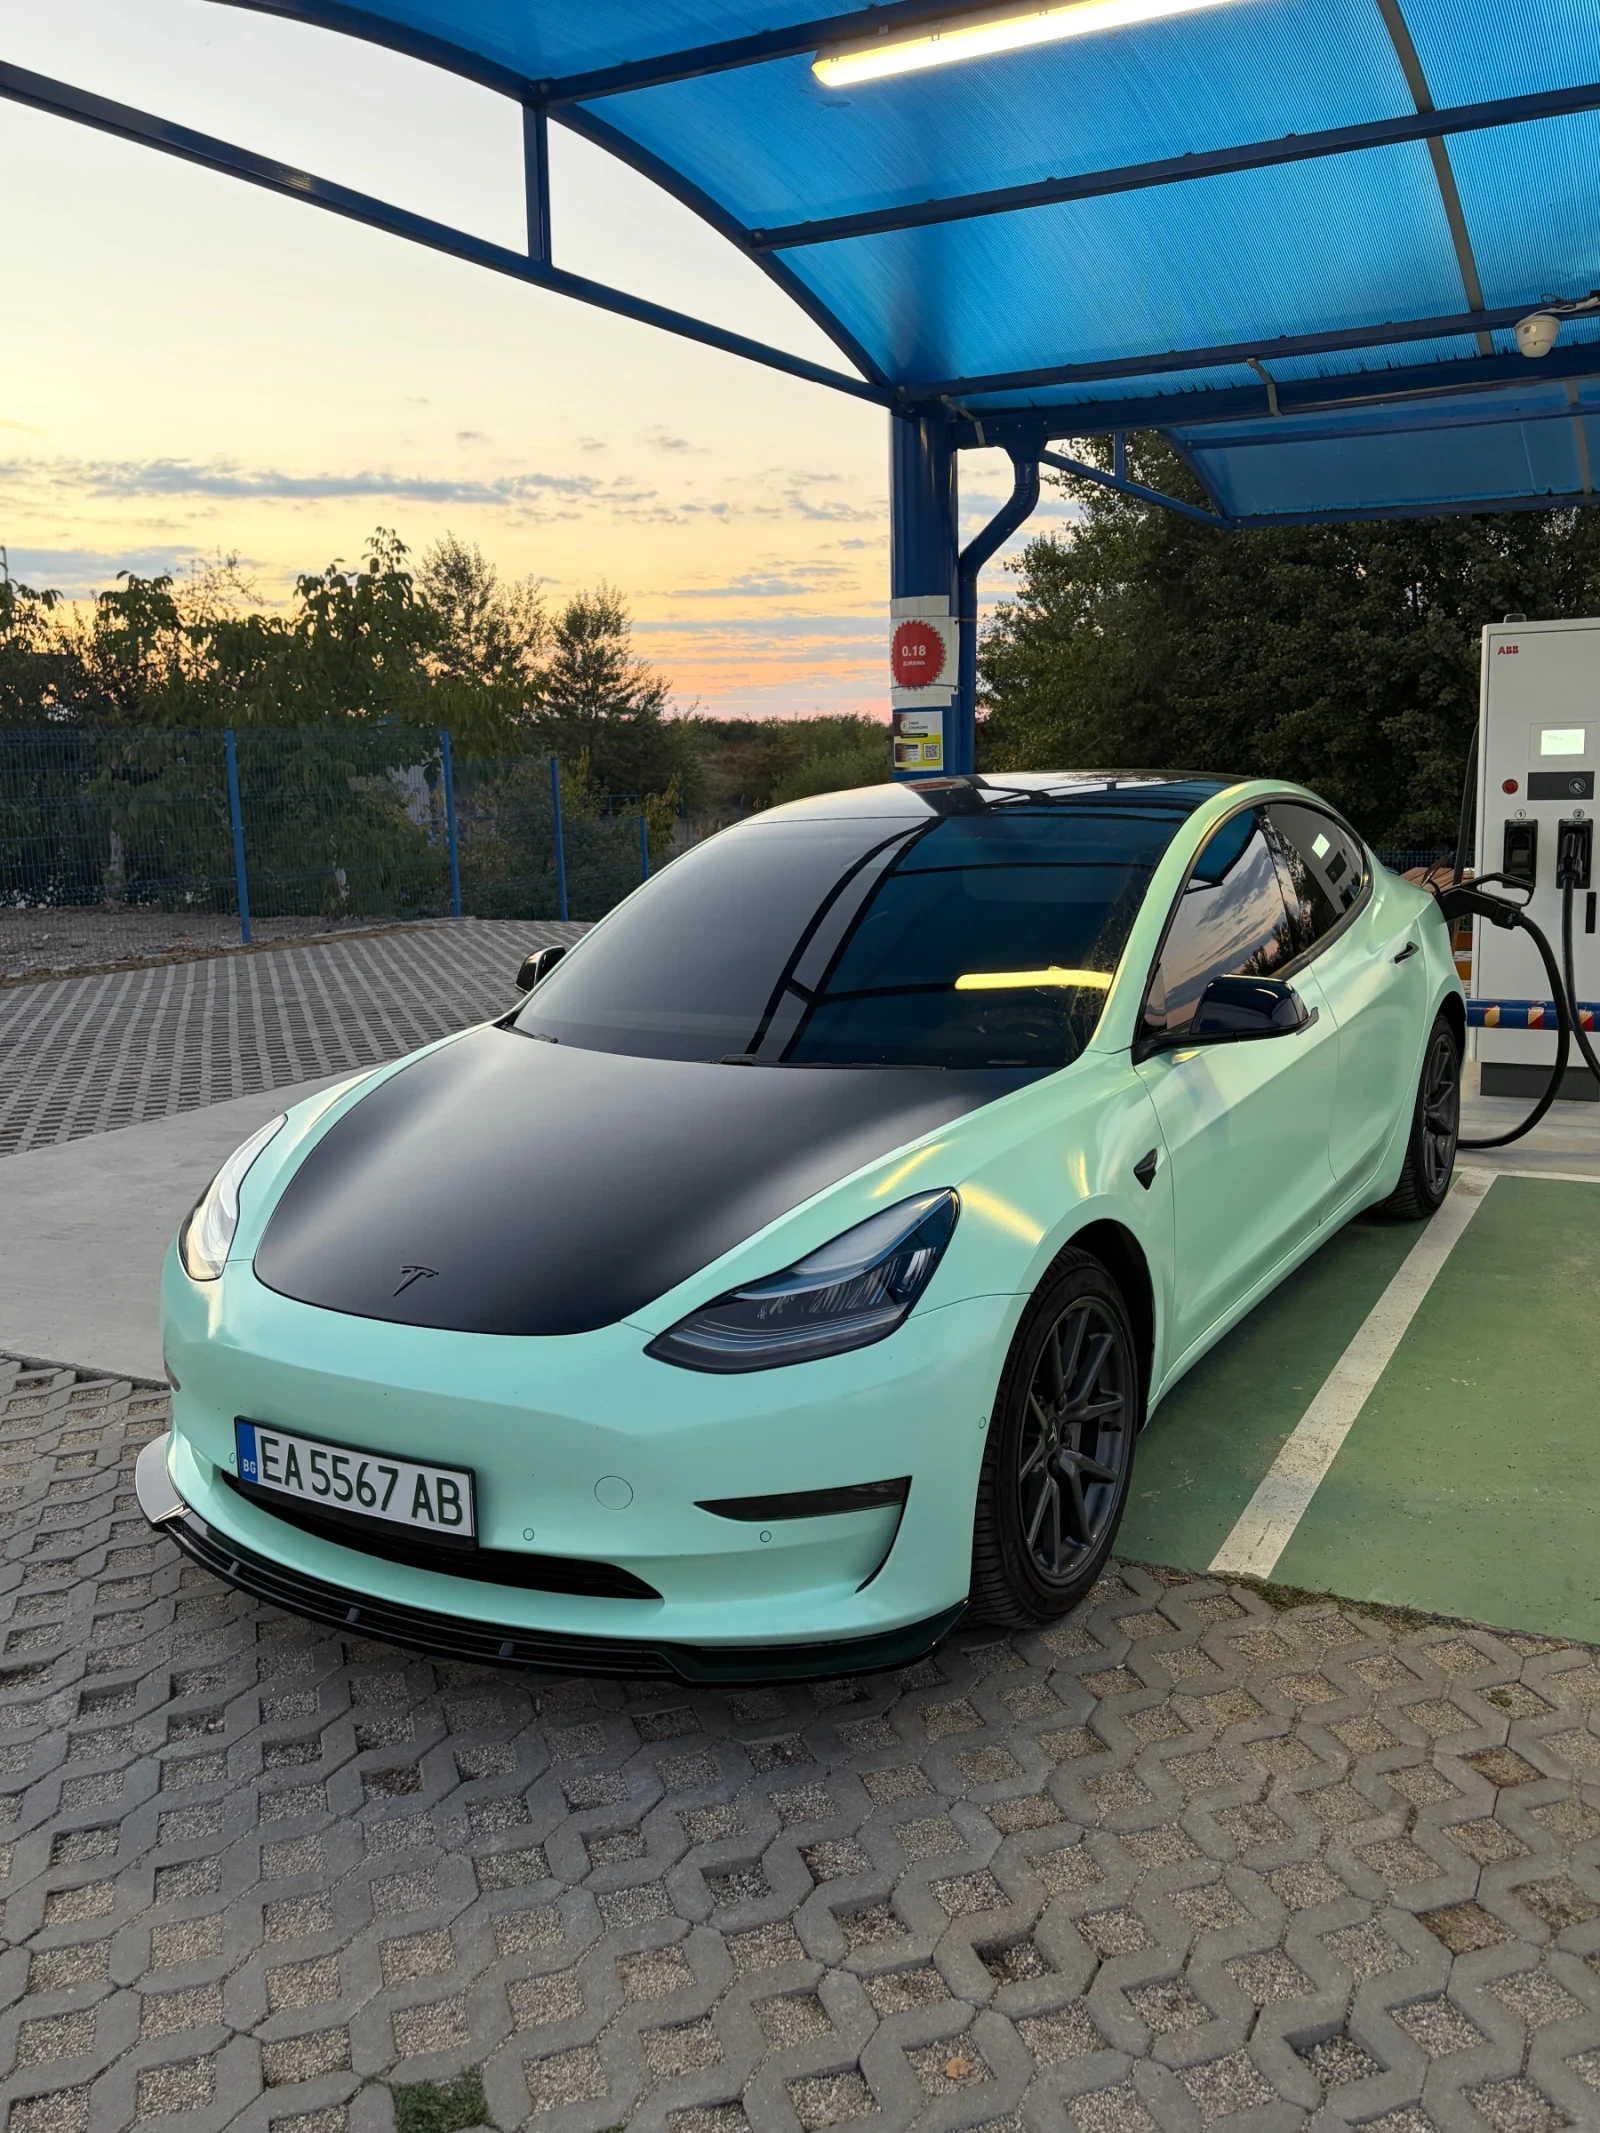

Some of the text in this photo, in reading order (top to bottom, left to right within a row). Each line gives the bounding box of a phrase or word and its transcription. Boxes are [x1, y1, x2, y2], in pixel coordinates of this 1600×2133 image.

[901, 645, 926, 657] 0.18
[1497, 645, 1519, 655] ABB
[242, 1459, 257, 1475] BG
[411, 1473, 463, 1527] AB
